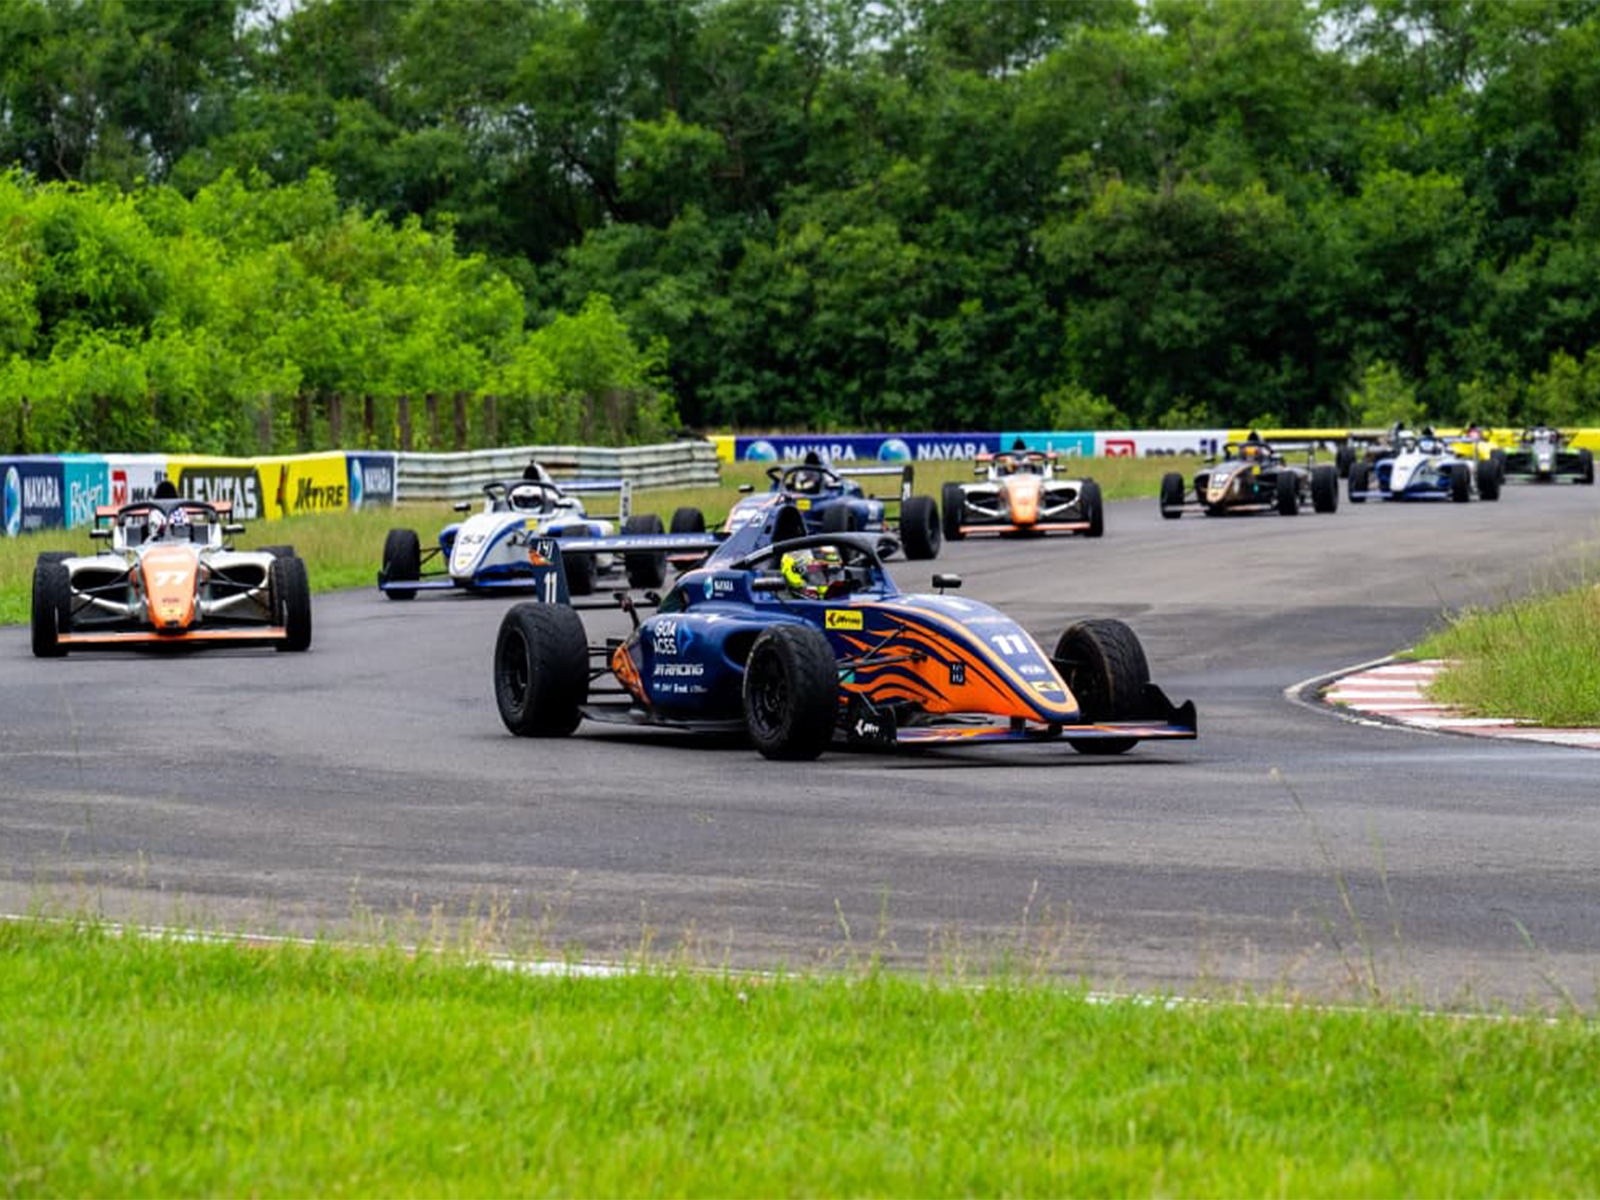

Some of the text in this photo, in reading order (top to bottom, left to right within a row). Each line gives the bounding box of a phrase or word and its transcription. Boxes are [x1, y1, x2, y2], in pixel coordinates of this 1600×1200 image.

[23, 475, 61, 509] NAYARA
[544, 571, 558, 604] 11
[991, 635, 1029, 655] 11
